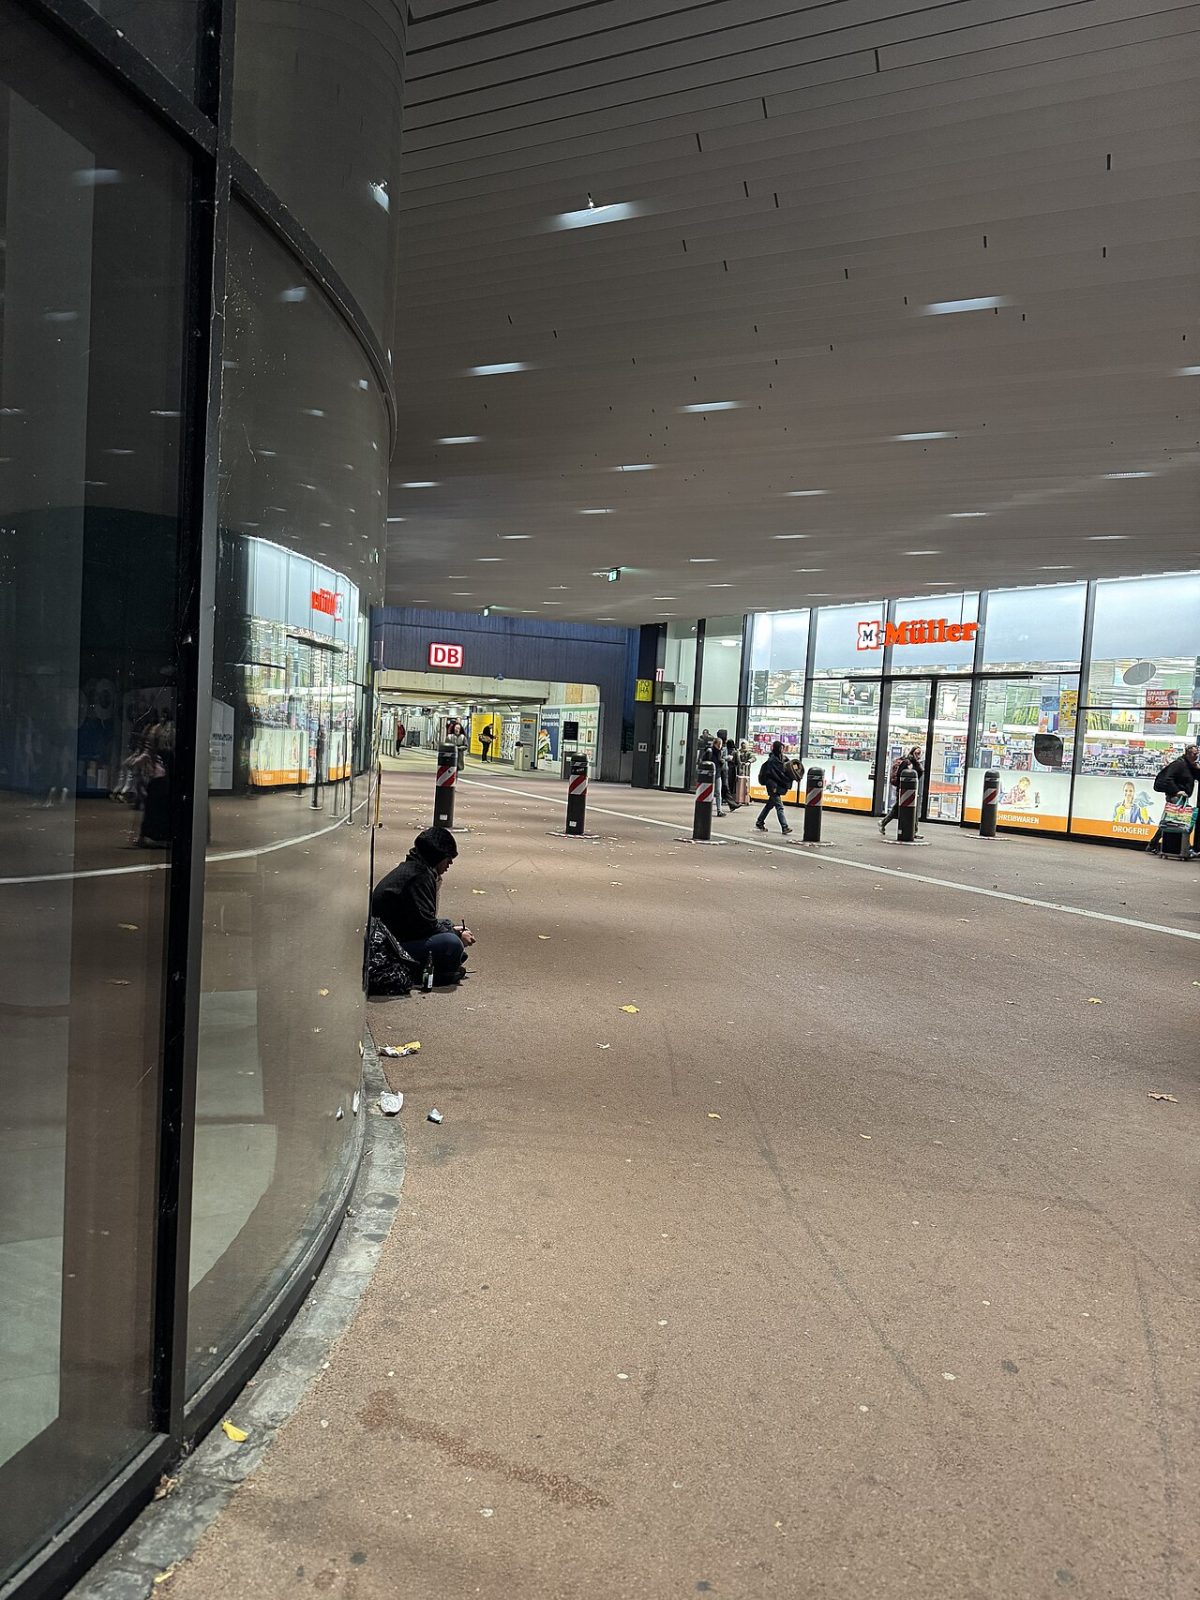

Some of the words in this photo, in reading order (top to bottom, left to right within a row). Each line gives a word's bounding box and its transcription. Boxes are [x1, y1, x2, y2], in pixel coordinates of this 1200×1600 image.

[884, 618, 978, 645] Müller
[434, 647, 459, 664] DB
[997, 814, 1040, 824] HREIBWAREN
[1112, 825, 1151, 836] DROGERIE
